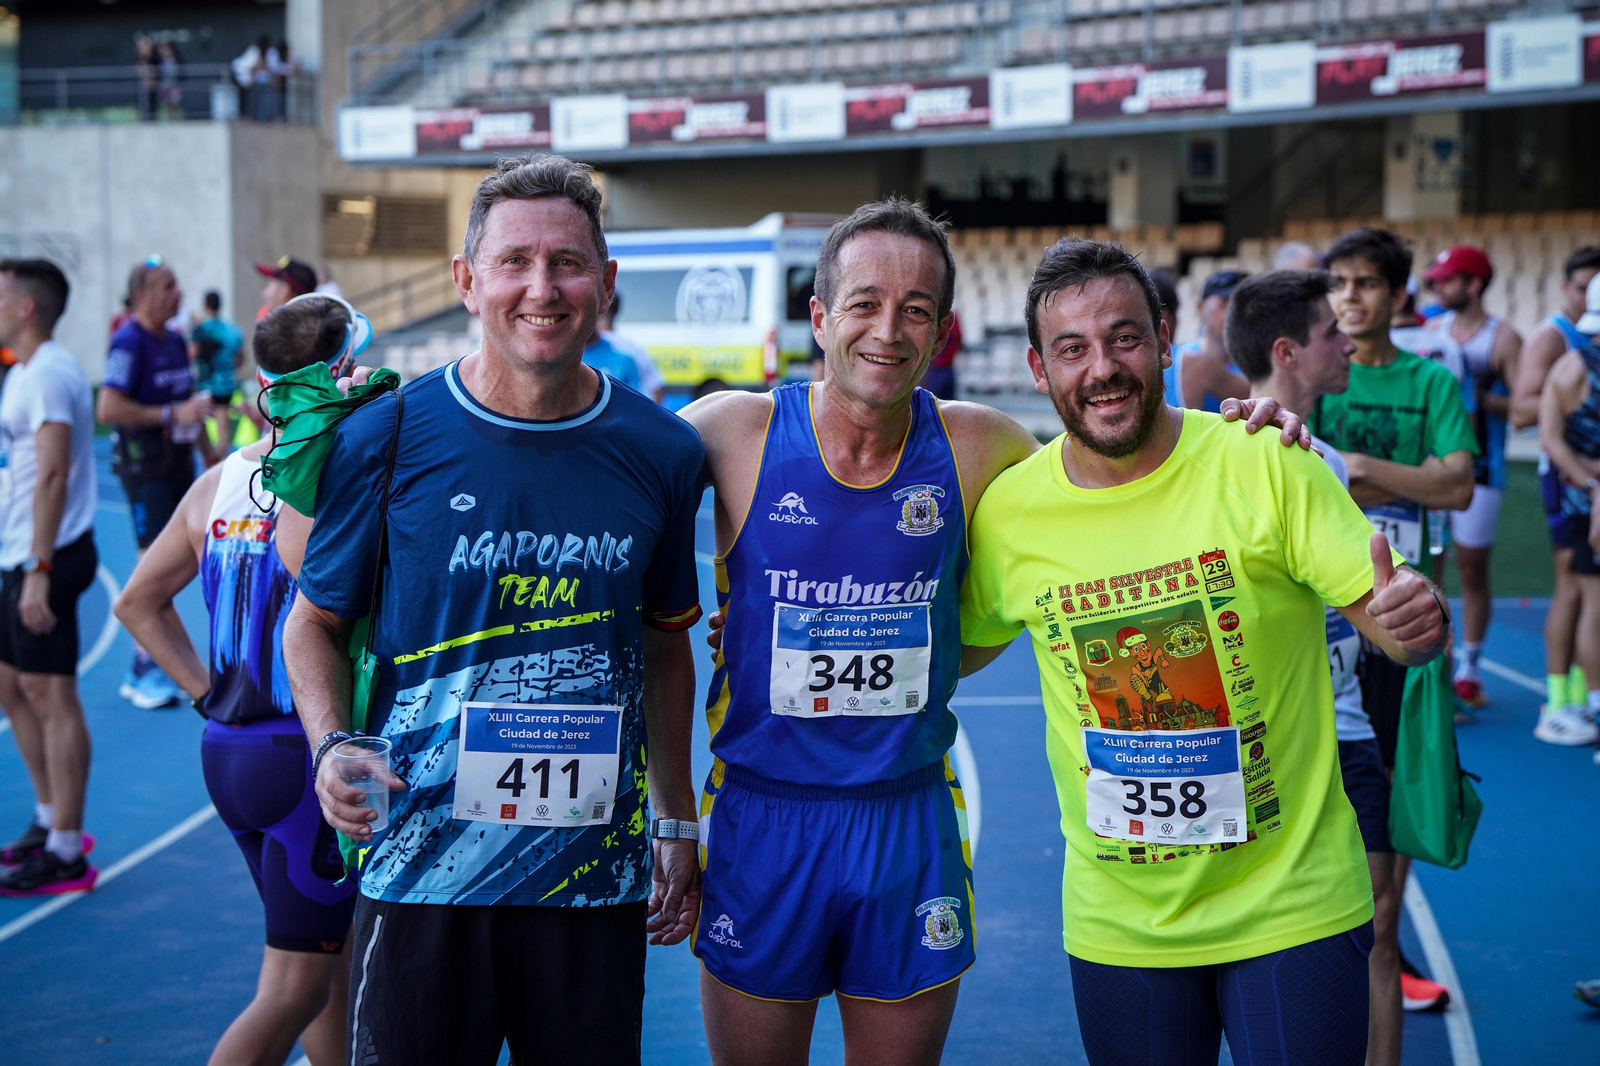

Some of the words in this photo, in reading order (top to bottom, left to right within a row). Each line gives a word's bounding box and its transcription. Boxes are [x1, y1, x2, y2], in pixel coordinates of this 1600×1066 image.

[768, 512, 819, 525] austral
[448, 530, 634, 579] AGAPORNIS
[1205, 560, 1226, 575] 29
[764, 568, 940, 605] Tirabuzón
[1058, 585, 1073, 599] II
[1075, 579, 1106, 596] SAN
[1109, 557, 1195, 590] SILVESTRE
[1208, 579, 1233, 591] 17:30
[498, 573, 580, 610] TEAM
[1061, 572, 1200, 614] GADITANA
[1066, 613, 1088, 622] Carrera
[1088, 608, 1116, 618] Solidaria
[1123, 599, 1160, 613] competitiva
[1160, 594, 1176, 603] 100%
[1177, 589, 1199, 600] asfalto
[798, 613, 822, 622] XLIII
[824, 612, 868, 622] Carrera
[870, 611, 914, 622] Popular
[808, 627, 850, 637] Ciudad
[852, 627, 868, 637] de
[870, 627, 900, 637] Jerez
[1050, 641, 1071, 653] aefat
[808, 654, 894, 692] 348
[488, 713, 512, 723] XLIII
[515, 713, 559, 724] Carrera
[562, 714, 605, 726] Popular
[499, 729, 540, 739] Ciudad
[543, 729, 558, 739] de
[561, 730, 590, 739] Jerez
[1103, 737, 1126, 747] XLIII
[1129, 739, 1173, 749] Carrera
[1176, 736, 1222, 749] Popular
[1115, 753, 1155, 764] Ciudad
[1158, 755, 1173, 763] de
[1175, 754, 1208, 764] Jerez
[1242, 757, 1270, 776] Estrella
[496, 758, 579, 799] 411
[1245, 767, 1271, 784] Galicia
[1120, 780, 1207, 819] 358
